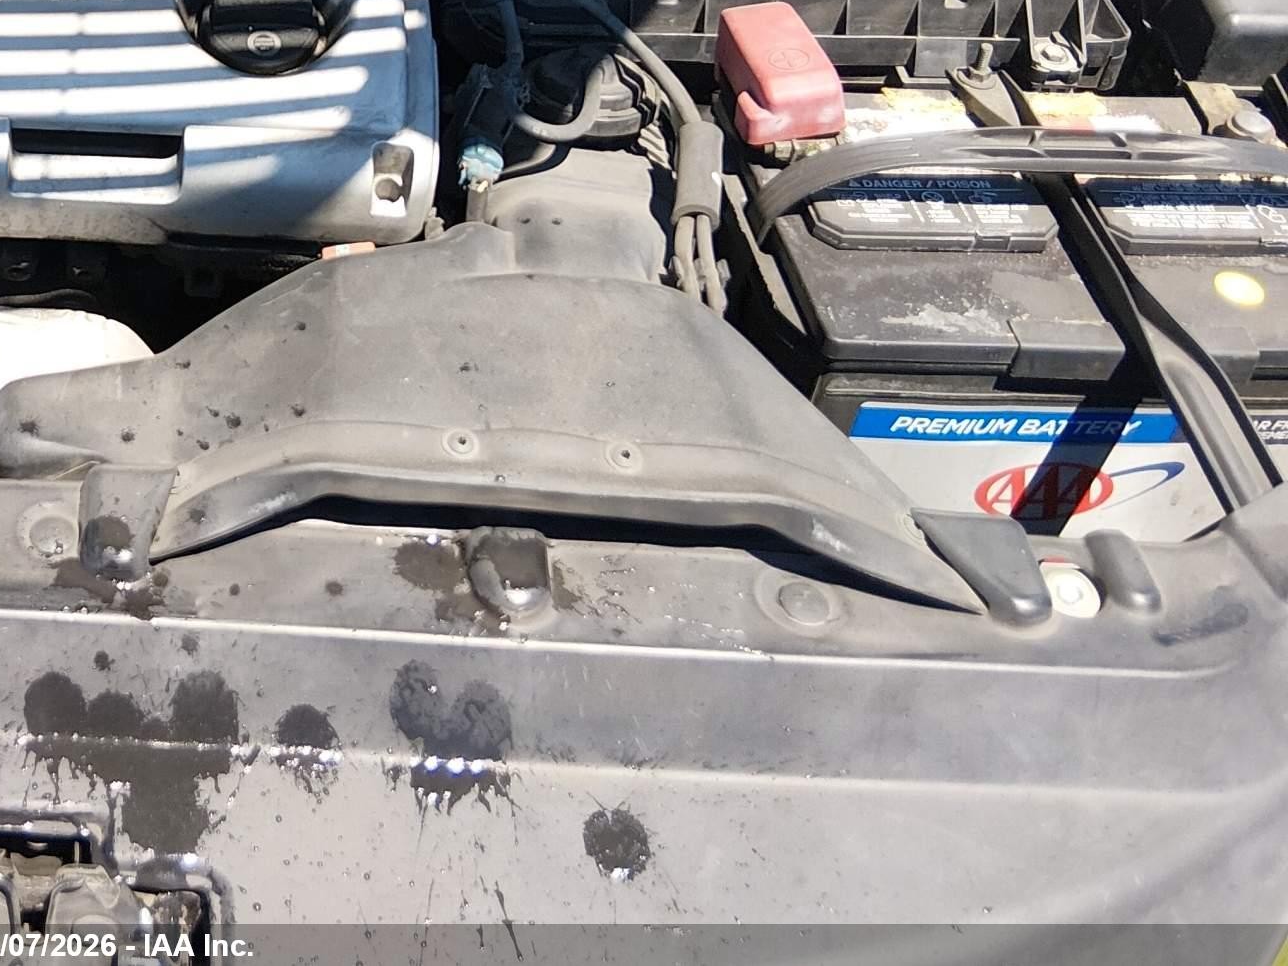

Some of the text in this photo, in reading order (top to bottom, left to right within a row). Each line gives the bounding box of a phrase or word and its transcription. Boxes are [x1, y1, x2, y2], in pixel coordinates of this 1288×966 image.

[862, 179, 923, 189] DANGER
[937, 179, 992, 189] POISON
[889, 416, 1143, 436] PREMIUM BATTERY
[978, 462, 1110, 520] AAA
